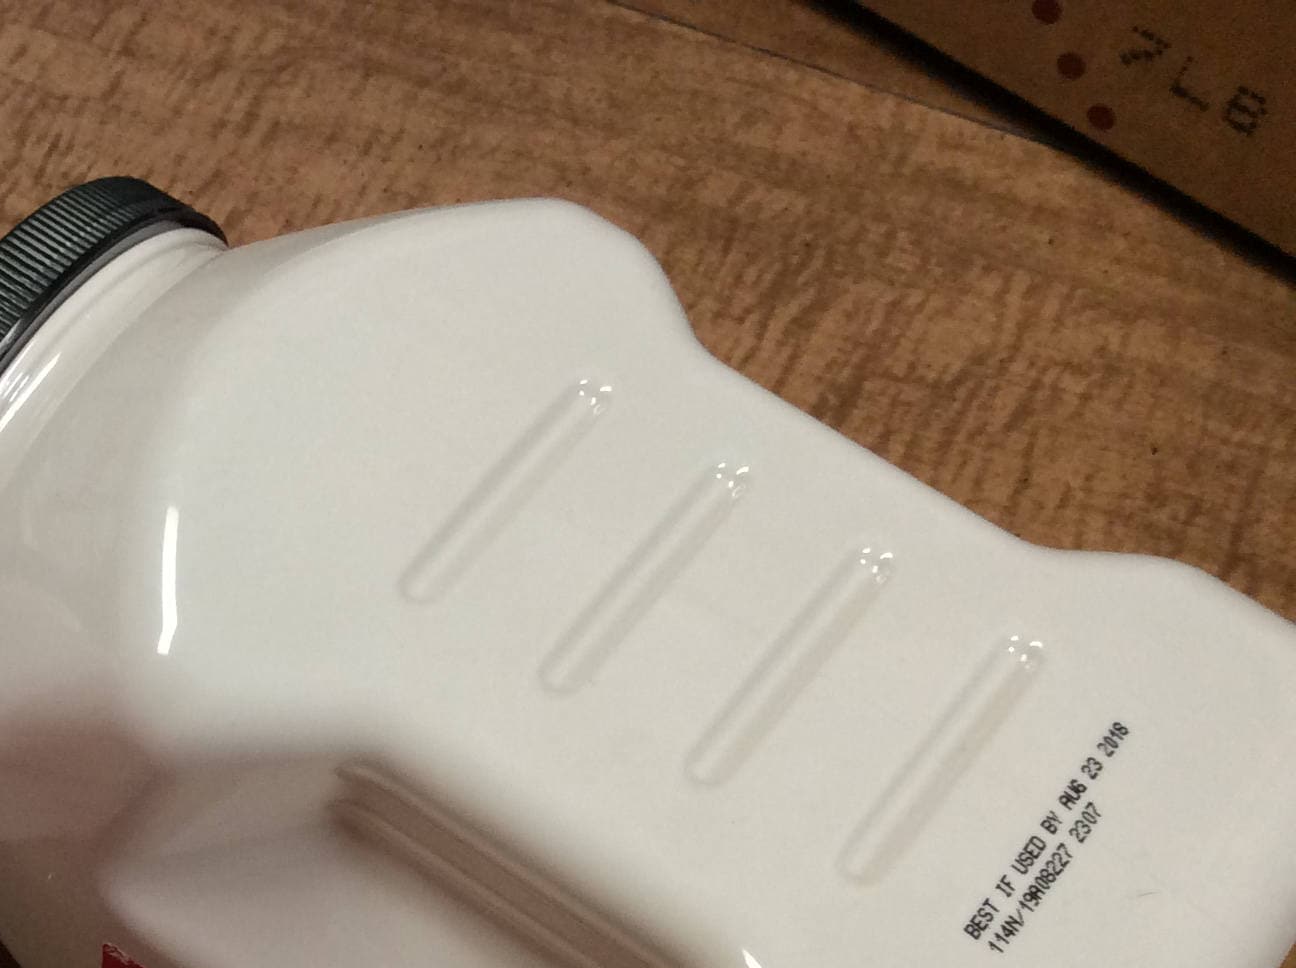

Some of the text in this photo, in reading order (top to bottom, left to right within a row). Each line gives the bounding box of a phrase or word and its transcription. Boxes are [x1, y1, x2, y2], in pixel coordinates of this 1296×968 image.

[963, 721, 1130, 940] BEST IF USED BY AUG 23 2018
[1068, 801, 1102, 844] 2307
